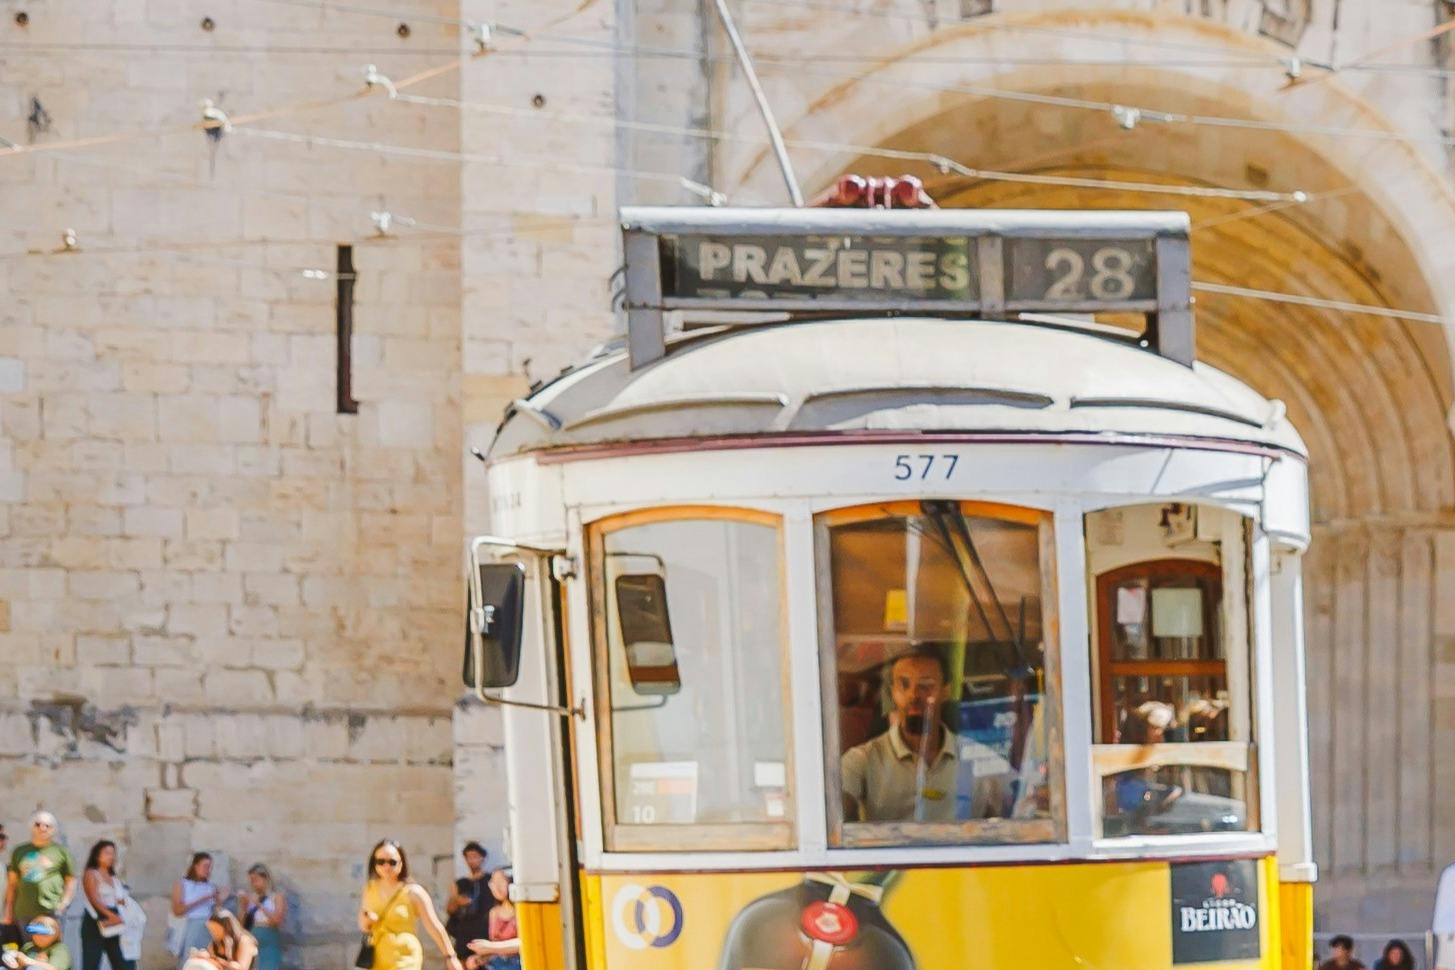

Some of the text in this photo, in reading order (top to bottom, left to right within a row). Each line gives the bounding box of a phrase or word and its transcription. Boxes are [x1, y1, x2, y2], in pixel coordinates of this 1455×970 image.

[700, 243, 1135, 299] PRAZERES 28
[895, 454, 959, 480] 577
[1181, 903, 1256, 932] BEIRÃO
